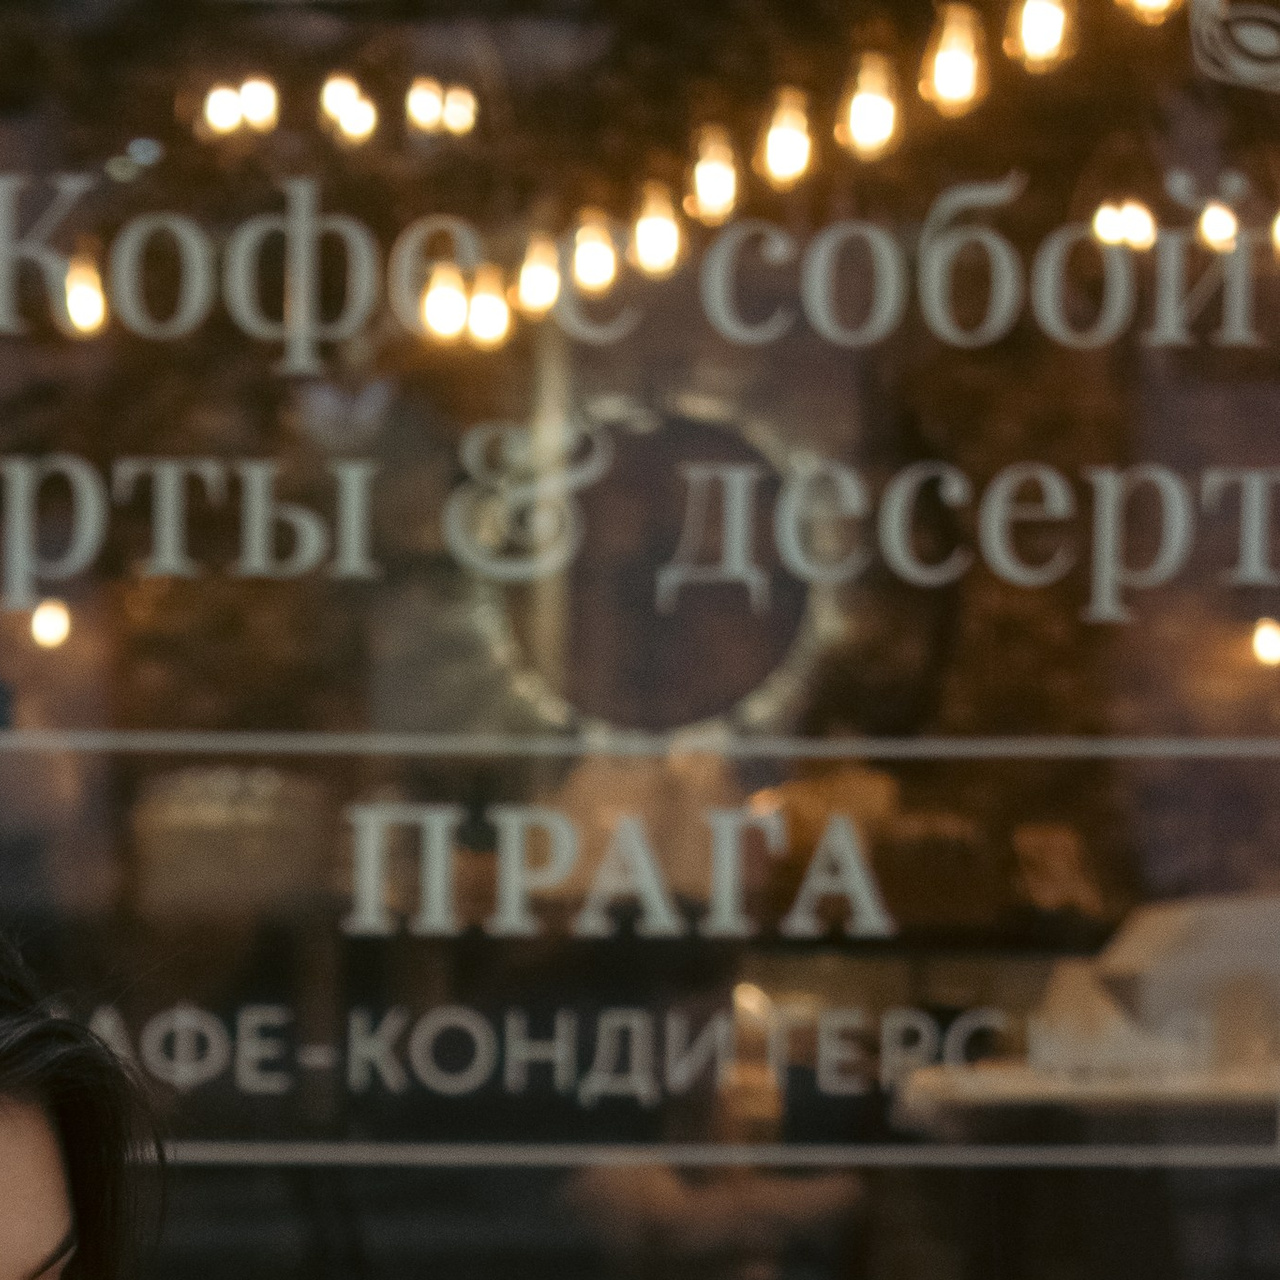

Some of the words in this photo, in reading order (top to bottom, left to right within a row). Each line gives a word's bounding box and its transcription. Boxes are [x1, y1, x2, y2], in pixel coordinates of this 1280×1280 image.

[699, 168, 1267, 348] собой
[441, 420, 616, 580] &
[654, 459, 1280, 624] десерт
[339, 801, 897, 939] ПРАГА
